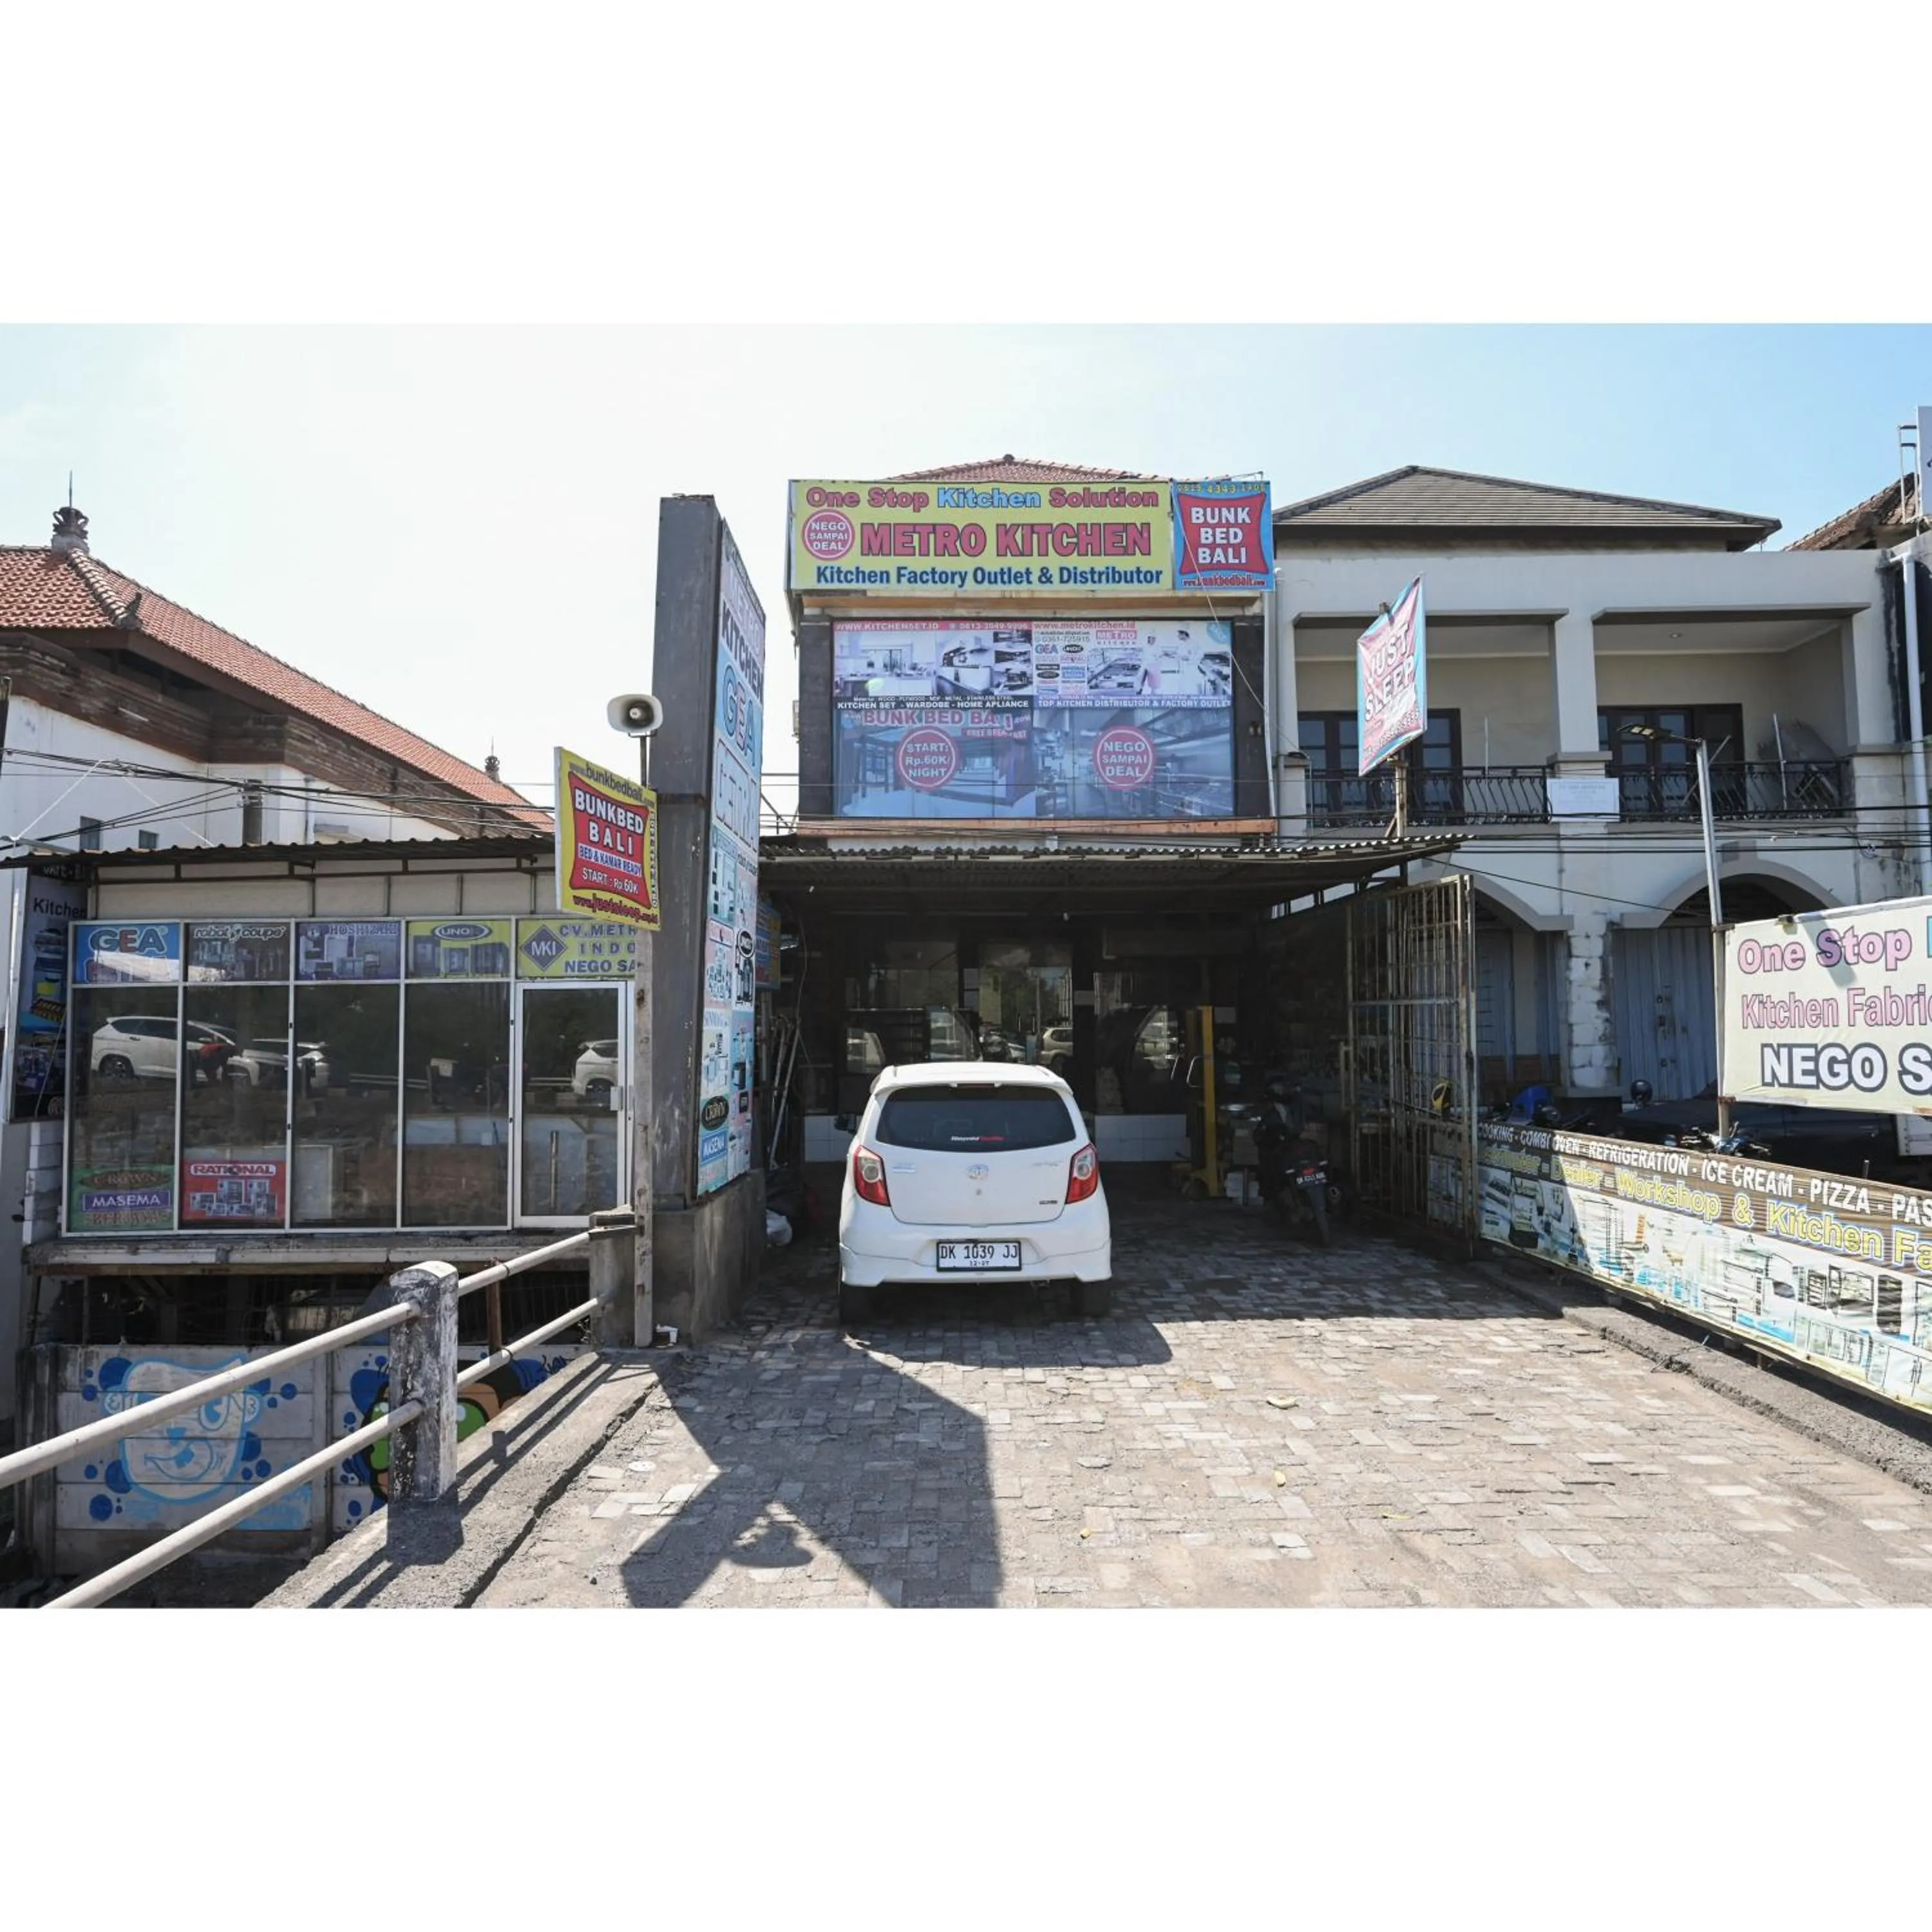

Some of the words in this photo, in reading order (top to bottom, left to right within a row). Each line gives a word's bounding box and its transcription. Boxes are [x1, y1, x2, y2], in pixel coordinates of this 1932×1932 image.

[806, 487, 860, 507] One
[868, 487, 929, 513] Stop
[938, 488, 1041, 508] Kitchen
[1049, 487, 1159, 508] Solution
[1191, 507, 1251, 524] BUNK
[811, 522, 846, 531] NEGO
[860, 523, 987, 557] METRO
[996, 523, 1151, 556] KITCHEN
[1200, 527, 1243, 544] BED
[813, 542, 845, 551] DEAL
[1198, 547, 1246, 564] BALI
[817, 566, 890, 584] Kitchen
[896, 567, 967, 587] Factory
[974, 567, 1032, 584] Outlet
[1037, 567, 1052, 584] &
[1059, 567, 1162, 584] Distributor
[722, 600, 763, 705] KITCHEN
[1036, 645, 1058, 654] GEA
[1368, 623, 1410, 684] JUST
[1365, 655, 1416, 722] SLEEP
[723, 665, 755, 766] GEA
[863, 709, 919, 726] BUNK
[923, 709, 965, 726] BED
[907, 743, 949, 753] START:
[1104, 742, 1144, 752] NEGO
[1103, 755, 1147, 763] SAMPAI
[1106, 766, 1142, 777] DEAL
[575, 789, 643, 833] BUNKBED
[589, 822, 633, 855] BALI
[582, 867, 607, 884] START
[89, 927, 167, 953] GEA
[531, 941, 556, 956] MKI
[1739, 938, 1806, 974] One
[1816, 926, 1913, 972] Stop
[565, 960, 612, 973] NEGO
[1741, 992, 1839, 1030] Kitchen
[1847, 984, 1932, 1027] Fabri
[1761, 1042, 1888, 1092] NEGO
[193, 1165, 274, 1175] RATIONAL
[1520, 1129, 1551, 1150] COMBI
[1552, 1133, 1579, 1155] OVEN
[1589, 1141, 1690, 1177] REFRIGERATION
[1701, 1158, 1728, 1185] ICE
[1732, 1162, 1794, 1198] CREAM
[1810, 1178, 1871, 1215] PIZZA
[92, 1195, 161, 1208] MASEMA
[1616, 1167, 1721, 1223] Workshop
[1732, 1193, 1754, 1227] &
[1766, 1200, 1884, 1262] Kitchen
[940, 1245, 956, 1258] DK
[964, 1245, 995, 1258] 1039
[1003, 1245, 1018, 1258] JJ
